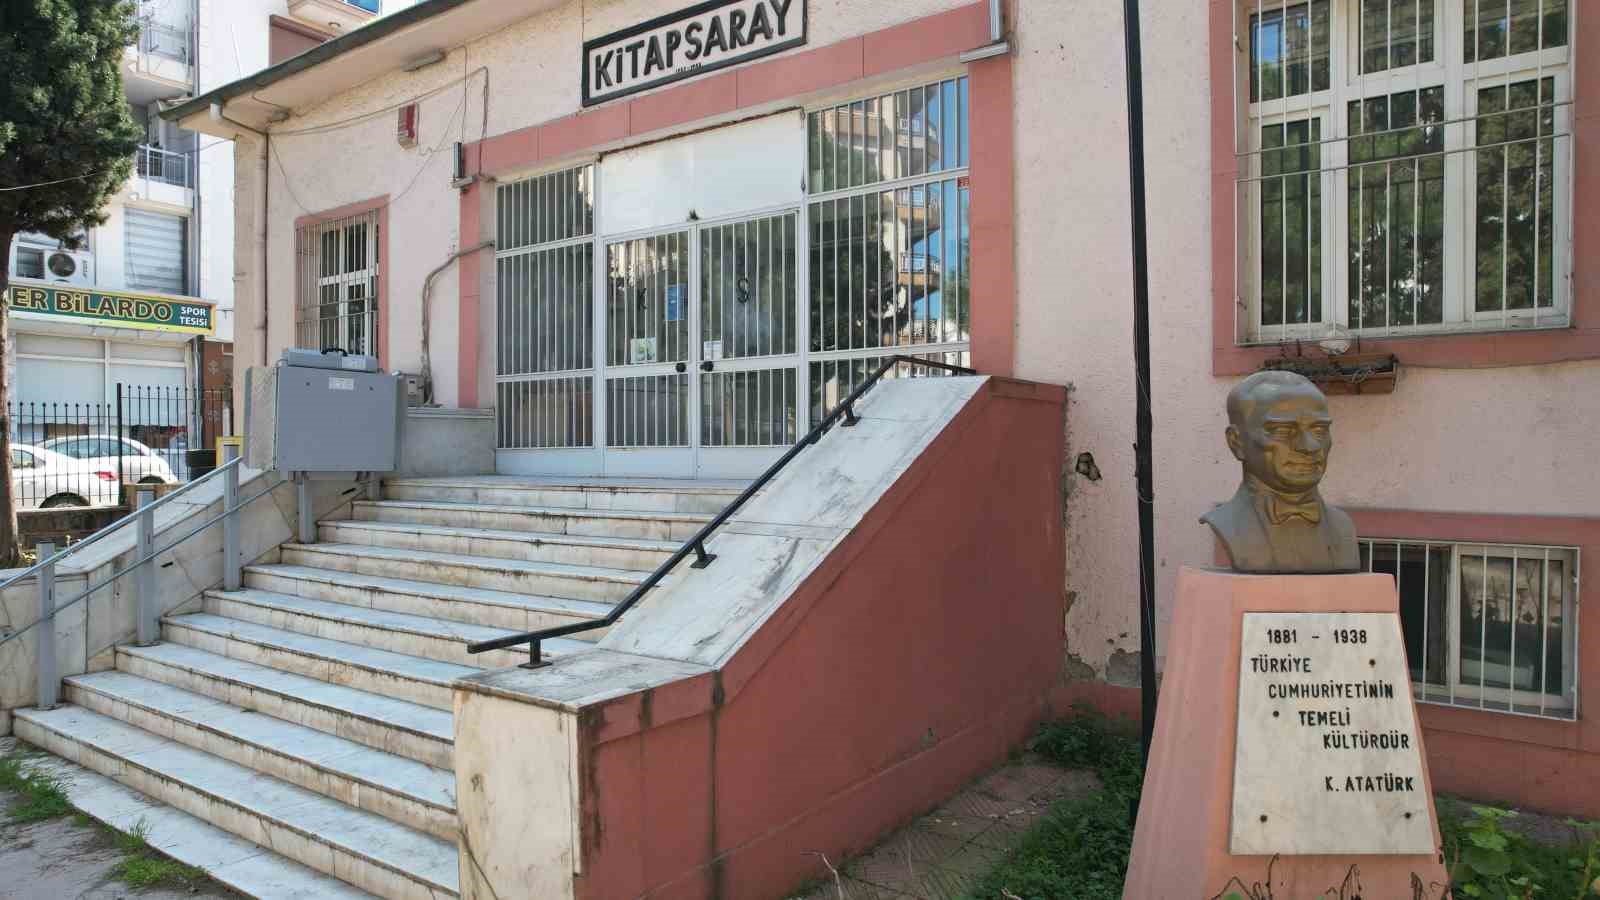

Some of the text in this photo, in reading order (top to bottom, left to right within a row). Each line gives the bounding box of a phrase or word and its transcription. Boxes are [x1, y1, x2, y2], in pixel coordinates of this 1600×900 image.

[181, 305, 206, 316] SPOR
[1267, 629, 1297, 644] 1881
[1333, 629, 1367, 644] 1938
[1251, 654, 1312, 673] TÜRKİYE
[1268, 680, 1393, 699] CUMHURİYETİNİN
[1298, 707, 1351, 726] TEMELİ
[1323, 730, 1410, 750] KÜLTÜRDÜR
[1325, 772, 1414, 792] K. ATATÜRK
